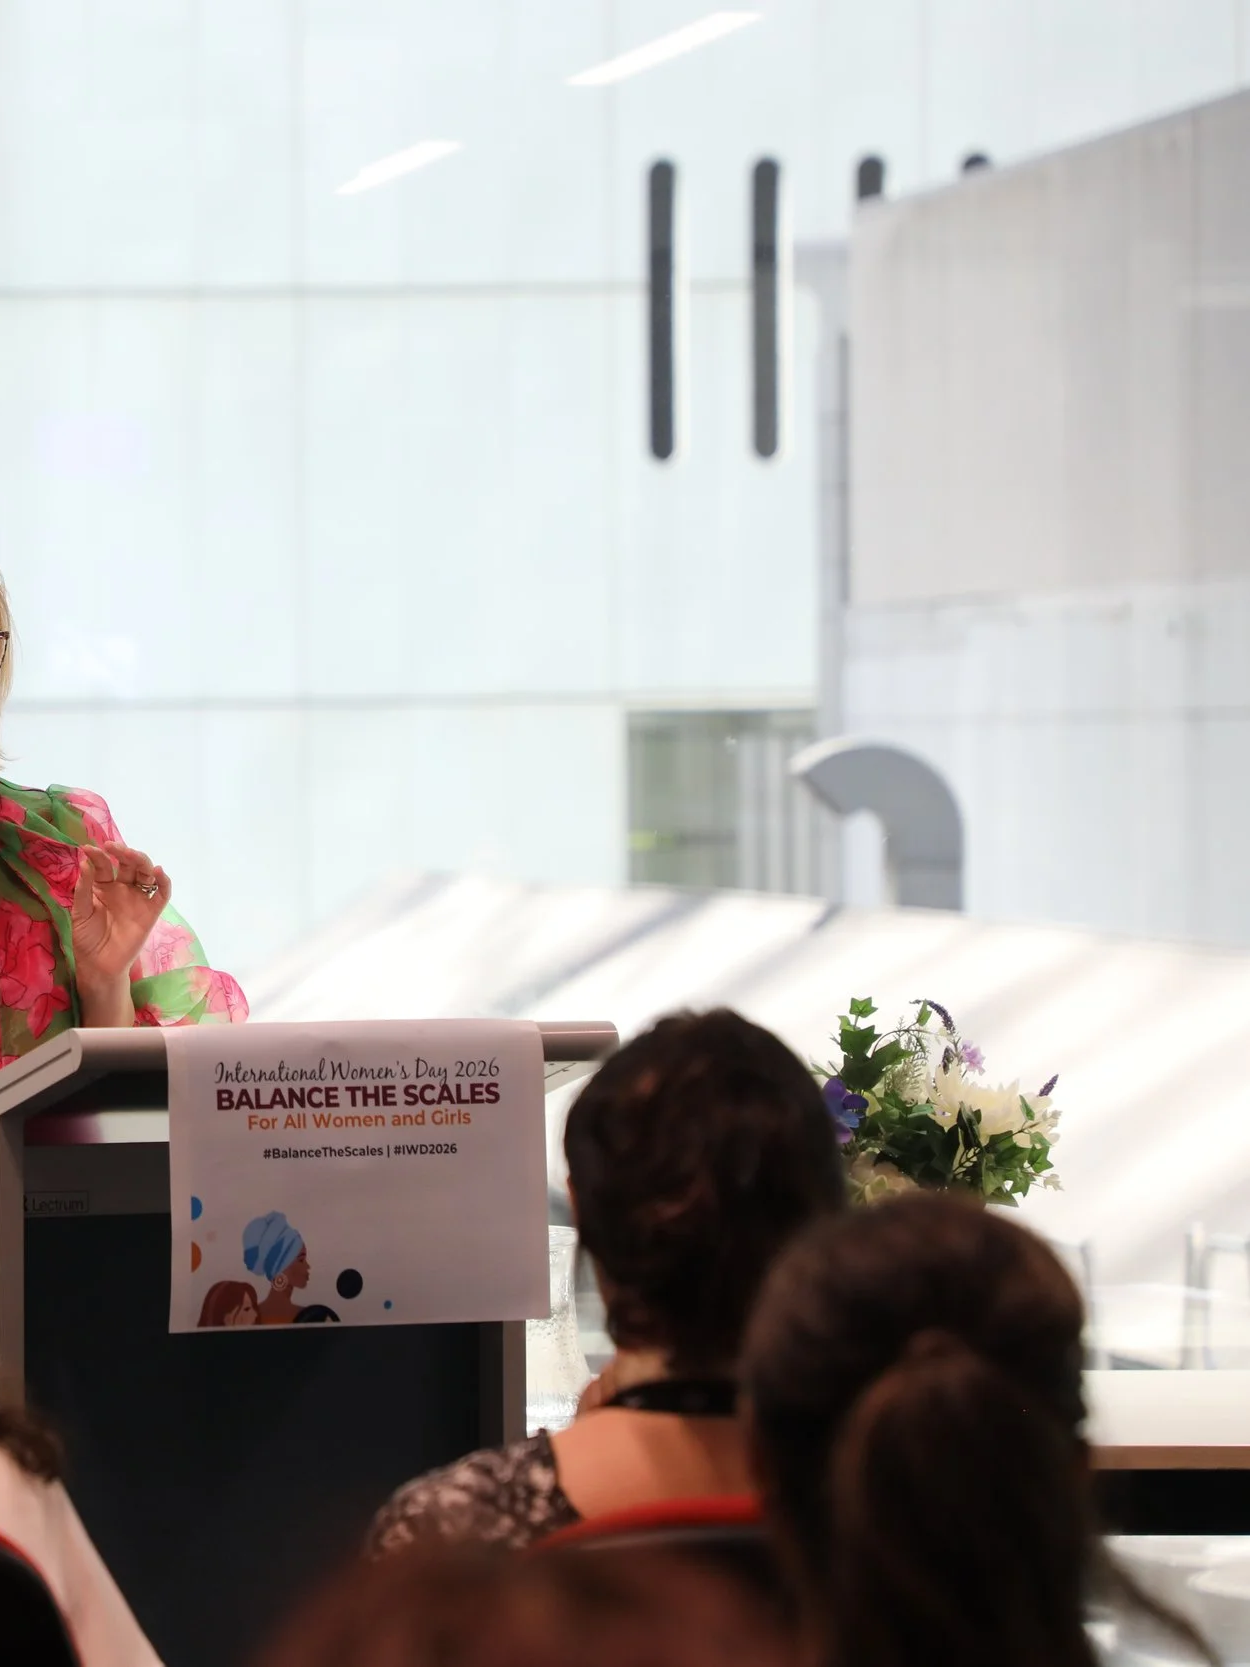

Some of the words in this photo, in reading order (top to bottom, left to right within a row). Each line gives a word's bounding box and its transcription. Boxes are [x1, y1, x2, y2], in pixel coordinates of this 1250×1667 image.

[214, 1057, 328, 1084] International
[330, 1059, 410, 1081] Women's
[414, 1056, 448, 1088] Day
[454, 1056, 500, 1078] 2026
[216, 1086, 340, 1111] BALANCE
[345, 1085, 398, 1107] THE
[403, 1082, 501, 1106] SCALES
[247, 1114, 278, 1130] For
[283, 1113, 307, 1129] All
[312, 1112, 386, 1129] Women
[391, 1109, 426, 1127] and
[430, 1108, 472, 1126] Girls
[263, 1145, 384, 1159] #BalanceTheScales
[393, 1143, 458, 1156] #IWD2026
[32, 1197, 84, 1212] Lectrum
